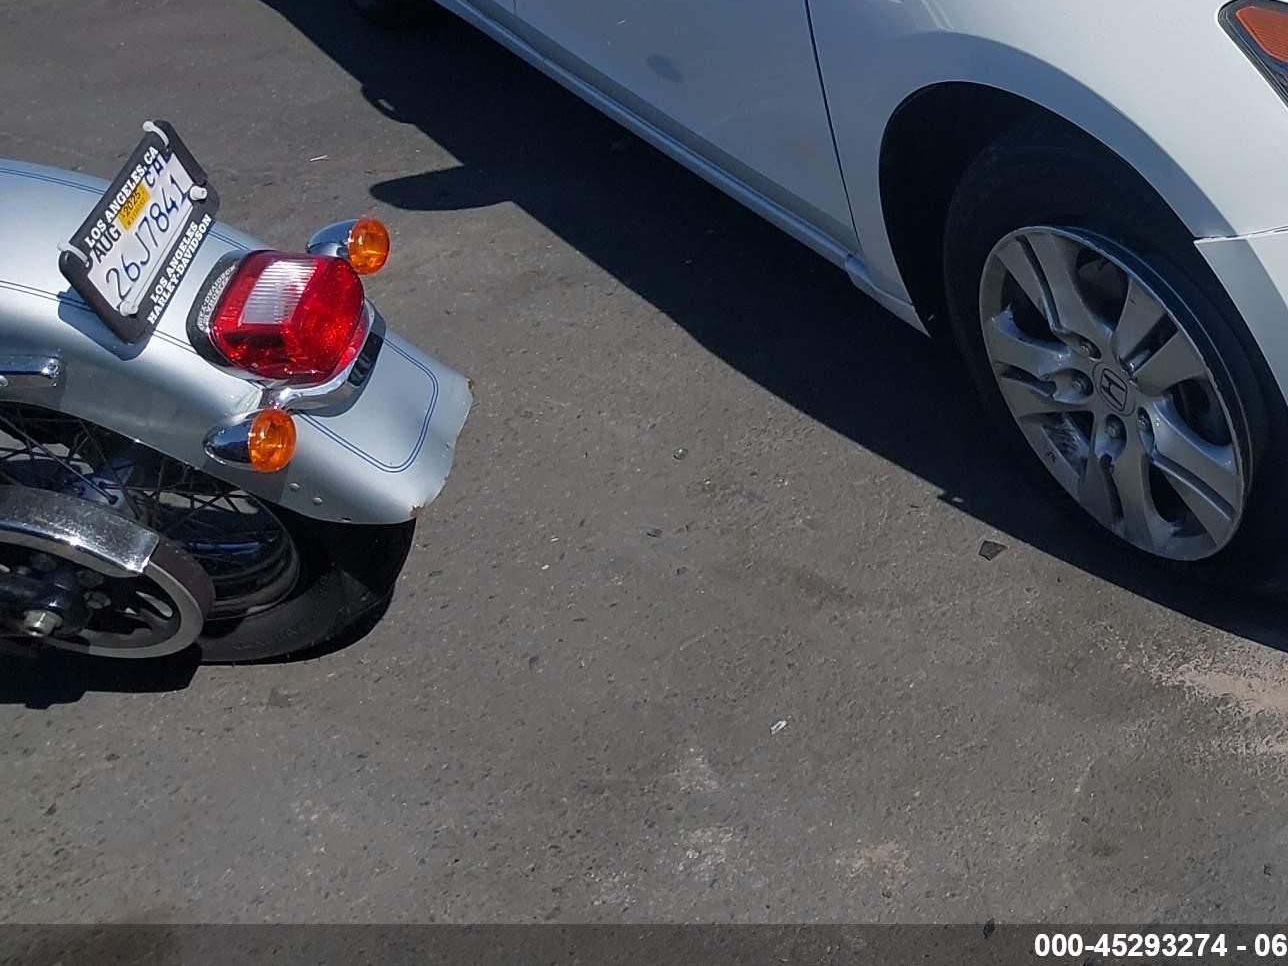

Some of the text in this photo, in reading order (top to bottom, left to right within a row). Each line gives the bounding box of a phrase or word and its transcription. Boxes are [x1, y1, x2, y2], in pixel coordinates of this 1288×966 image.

[84, 218, 107, 248] LOS
[105, 164, 148, 223] ANGELES,
[144, 146, 159, 165] CA
[92, 224, 121, 264] AUG
[123, 192, 141, 216] 2025
[106, 173, 188, 300] 26J7841
[147, 214, 212, 325] HARLEY-DAVIDSON
[150, 221, 198, 303] LOS ANGELES
